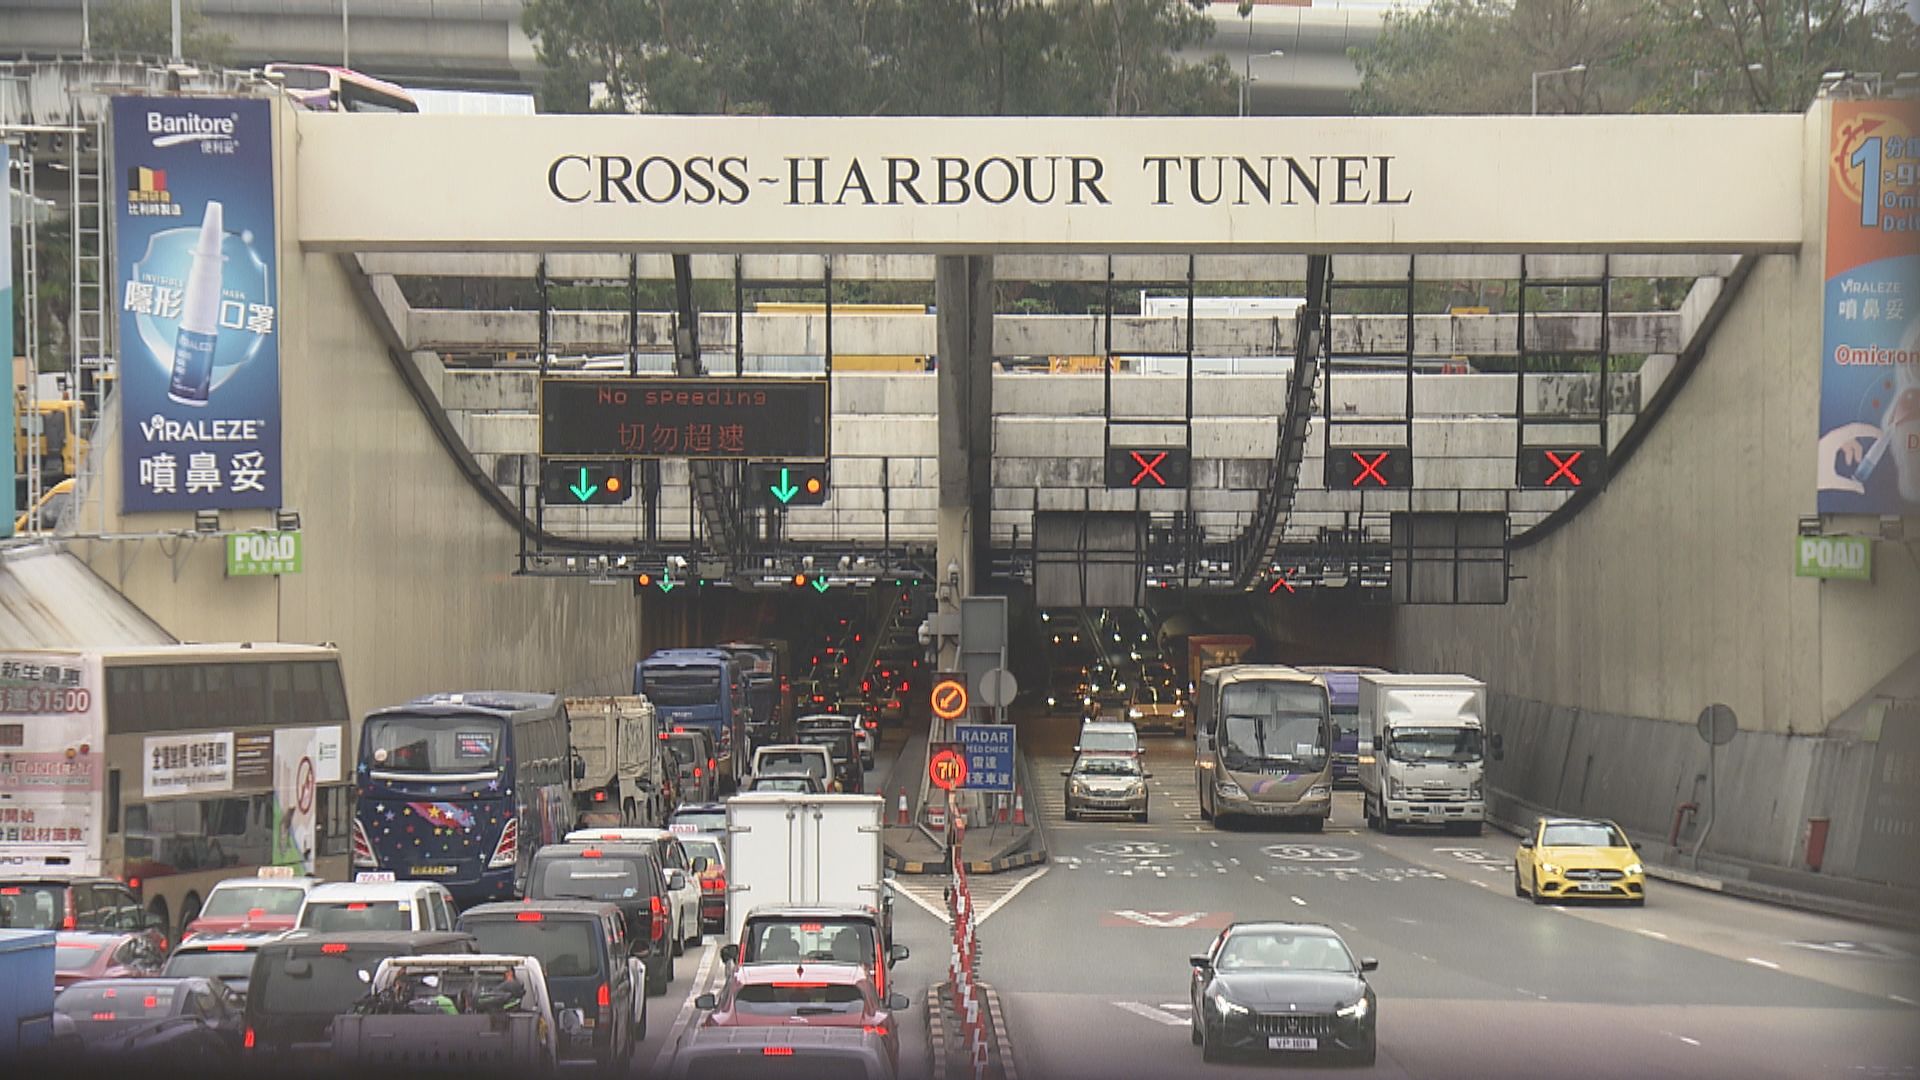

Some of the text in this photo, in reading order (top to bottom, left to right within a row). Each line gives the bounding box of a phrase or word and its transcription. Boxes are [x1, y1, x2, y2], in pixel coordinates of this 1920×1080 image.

[147, 112, 234, 133] Banitore
[1143, 156, 1412, 205] TUNNEL
[1851, 136, 1882, 227] 1
[124, 280, 183, 318] 隱形
[219, 300, 274, 334] 口罩
[598, 387, 767, 406] No speeding
[617, 422, 745, 452] 切勿超速
[139, 451, 266, 494] 噴鼻妥
[235, 536, 295, 561] POAD
[1801, 541, 1865, 568] POAD
[961, 731, 1009, 743] RADAR
[966, 745, 983, 753] PEED
[966, 772, 1010, 785] 查車速
[359, 872, 393, 882] TAXI
